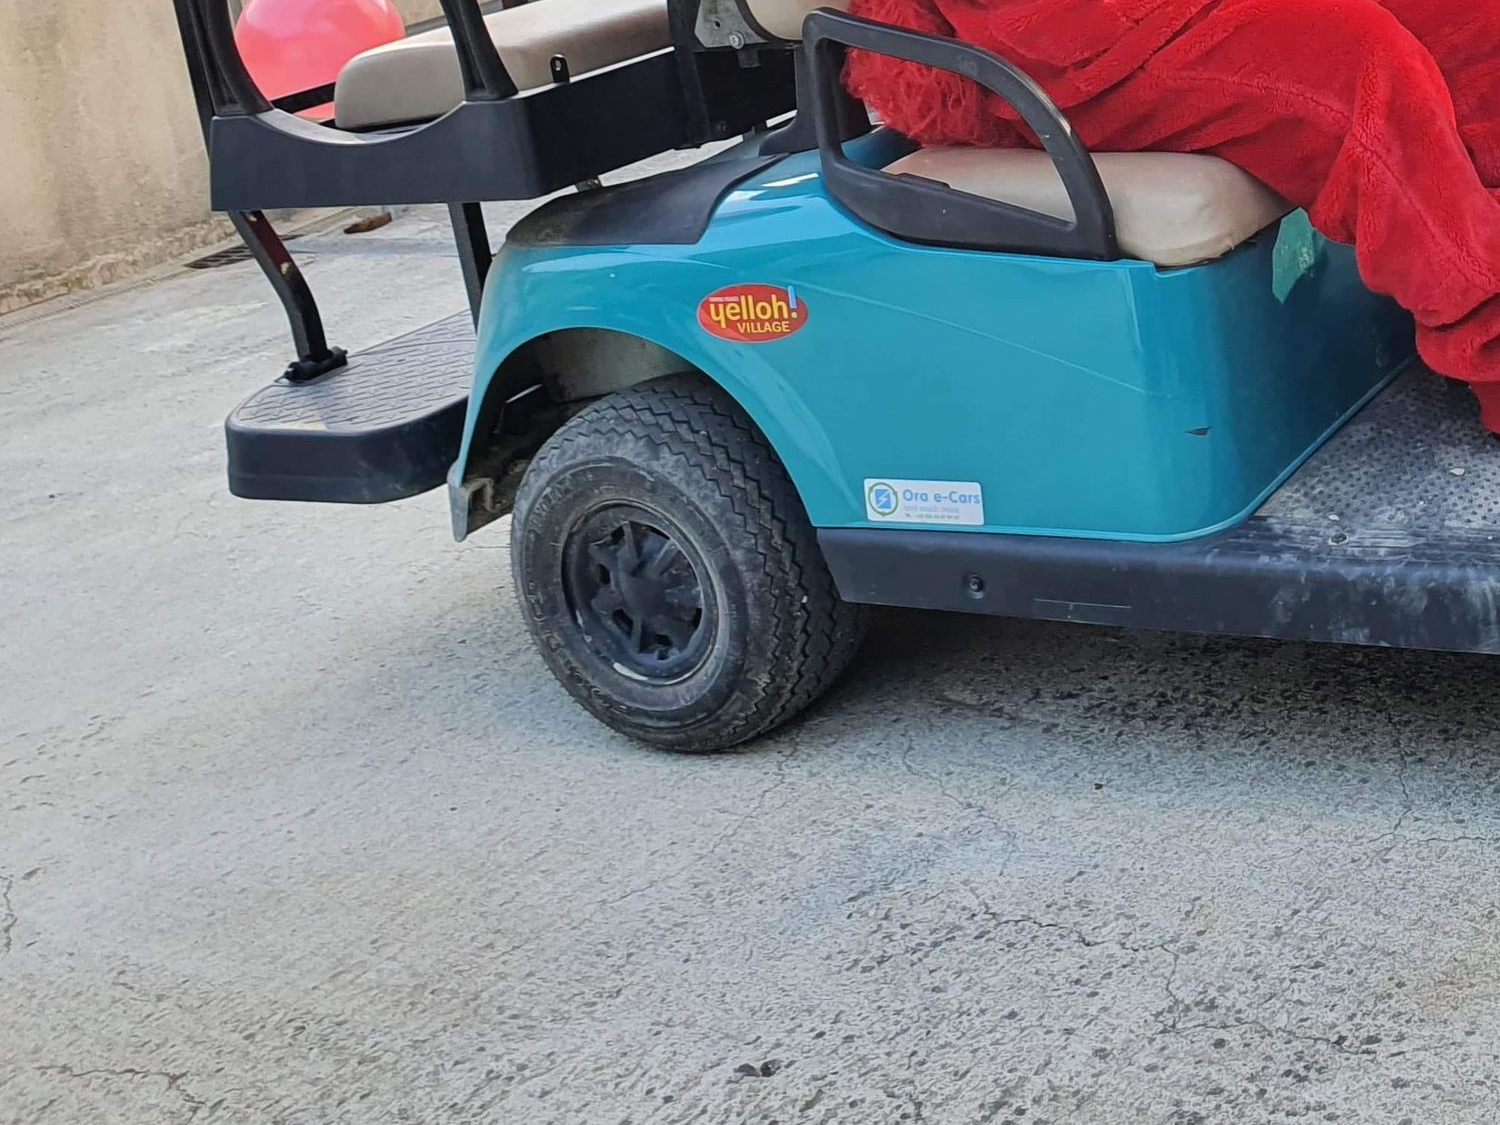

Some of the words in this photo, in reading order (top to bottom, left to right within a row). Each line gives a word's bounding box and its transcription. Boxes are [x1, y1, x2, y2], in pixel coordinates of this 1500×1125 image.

[709, 285, 798, 329] yelloh!
[736, 321, 791, 333] VILLAGE
[902, 489, 929, 502] Ora
[933, 490, 981, 504] e-Cars
